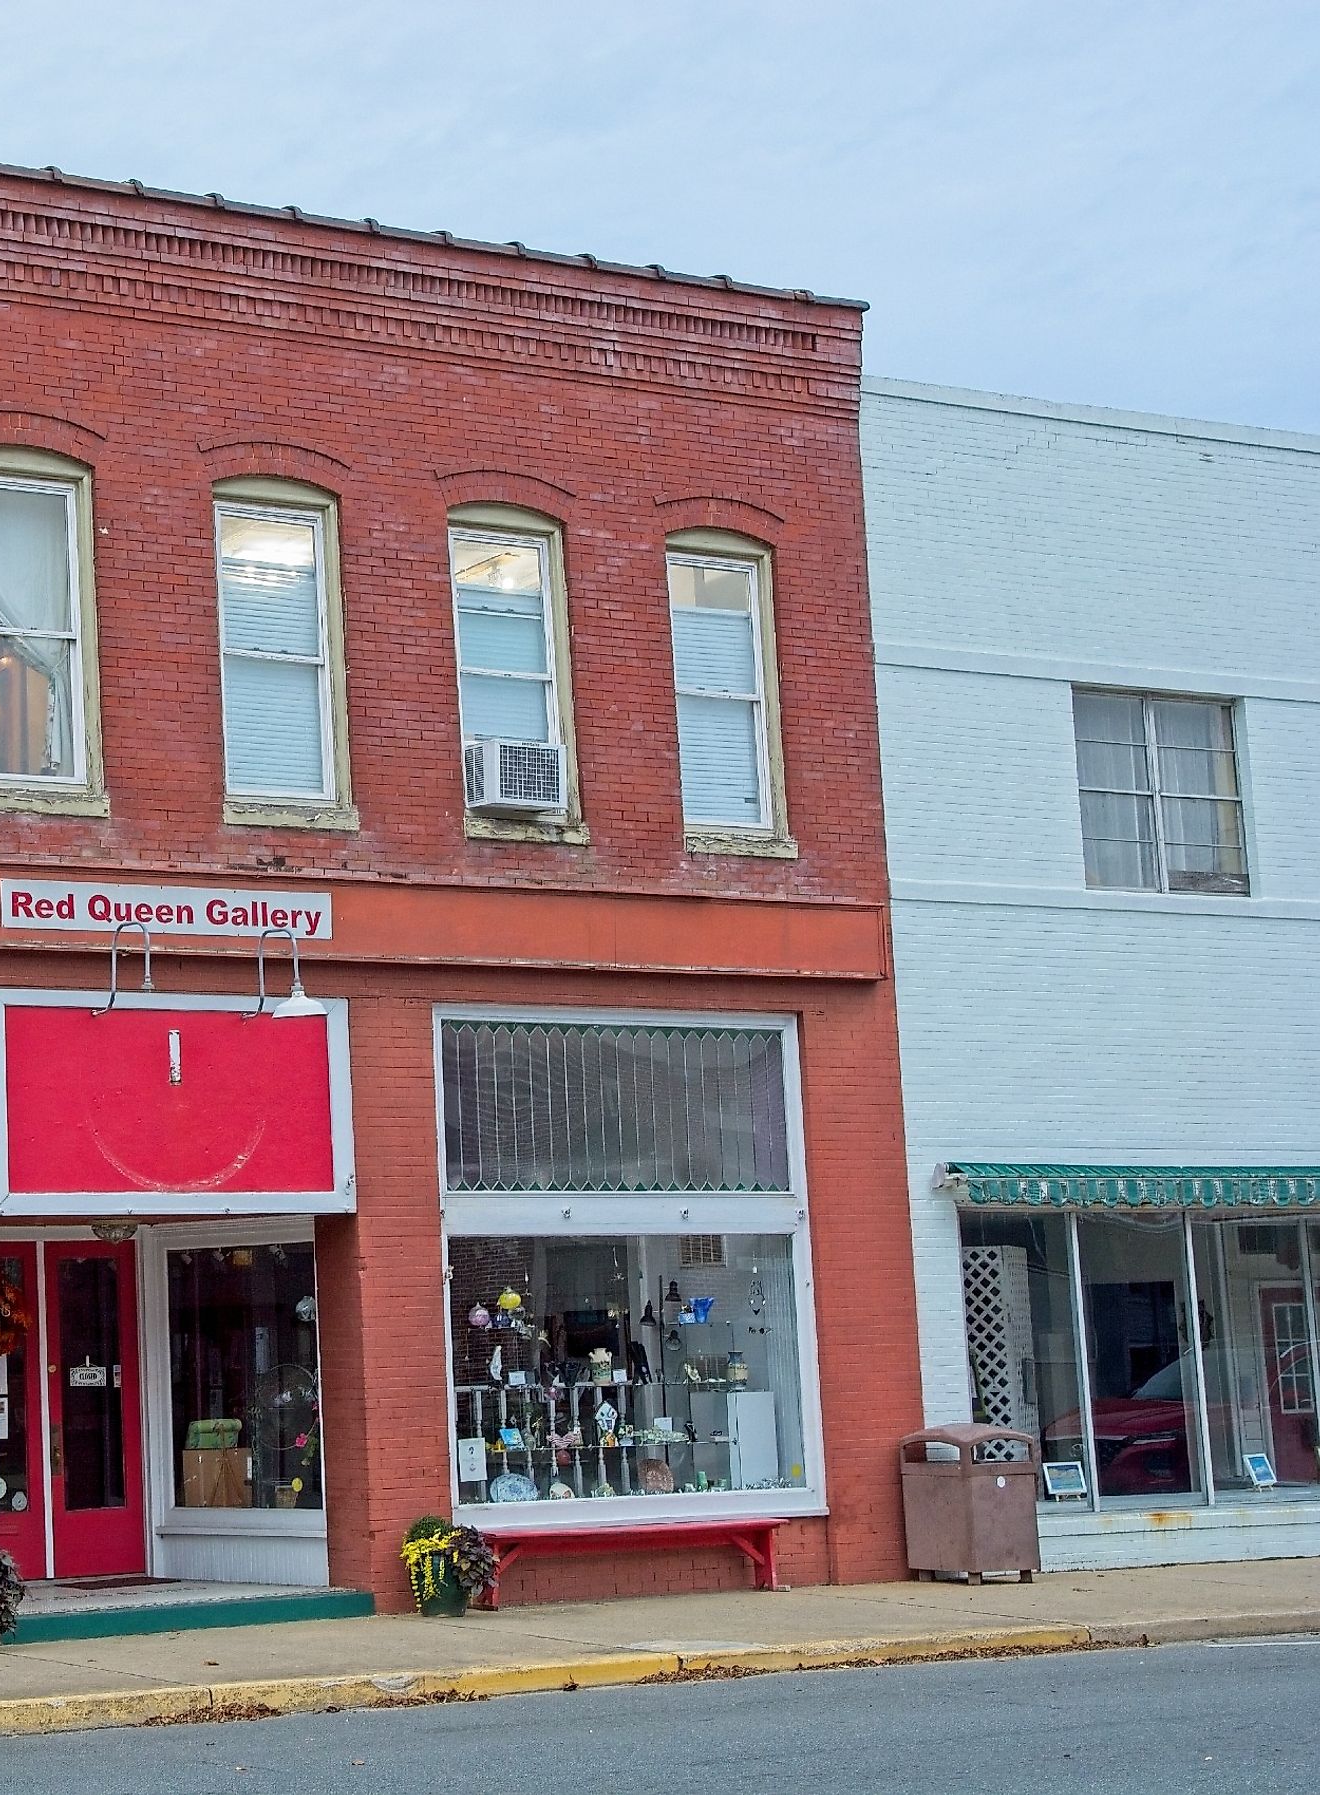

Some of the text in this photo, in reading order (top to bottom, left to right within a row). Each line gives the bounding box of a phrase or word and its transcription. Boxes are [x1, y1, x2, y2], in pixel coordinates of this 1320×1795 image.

[11, 891, 322, 935] Red Queen Gallery
